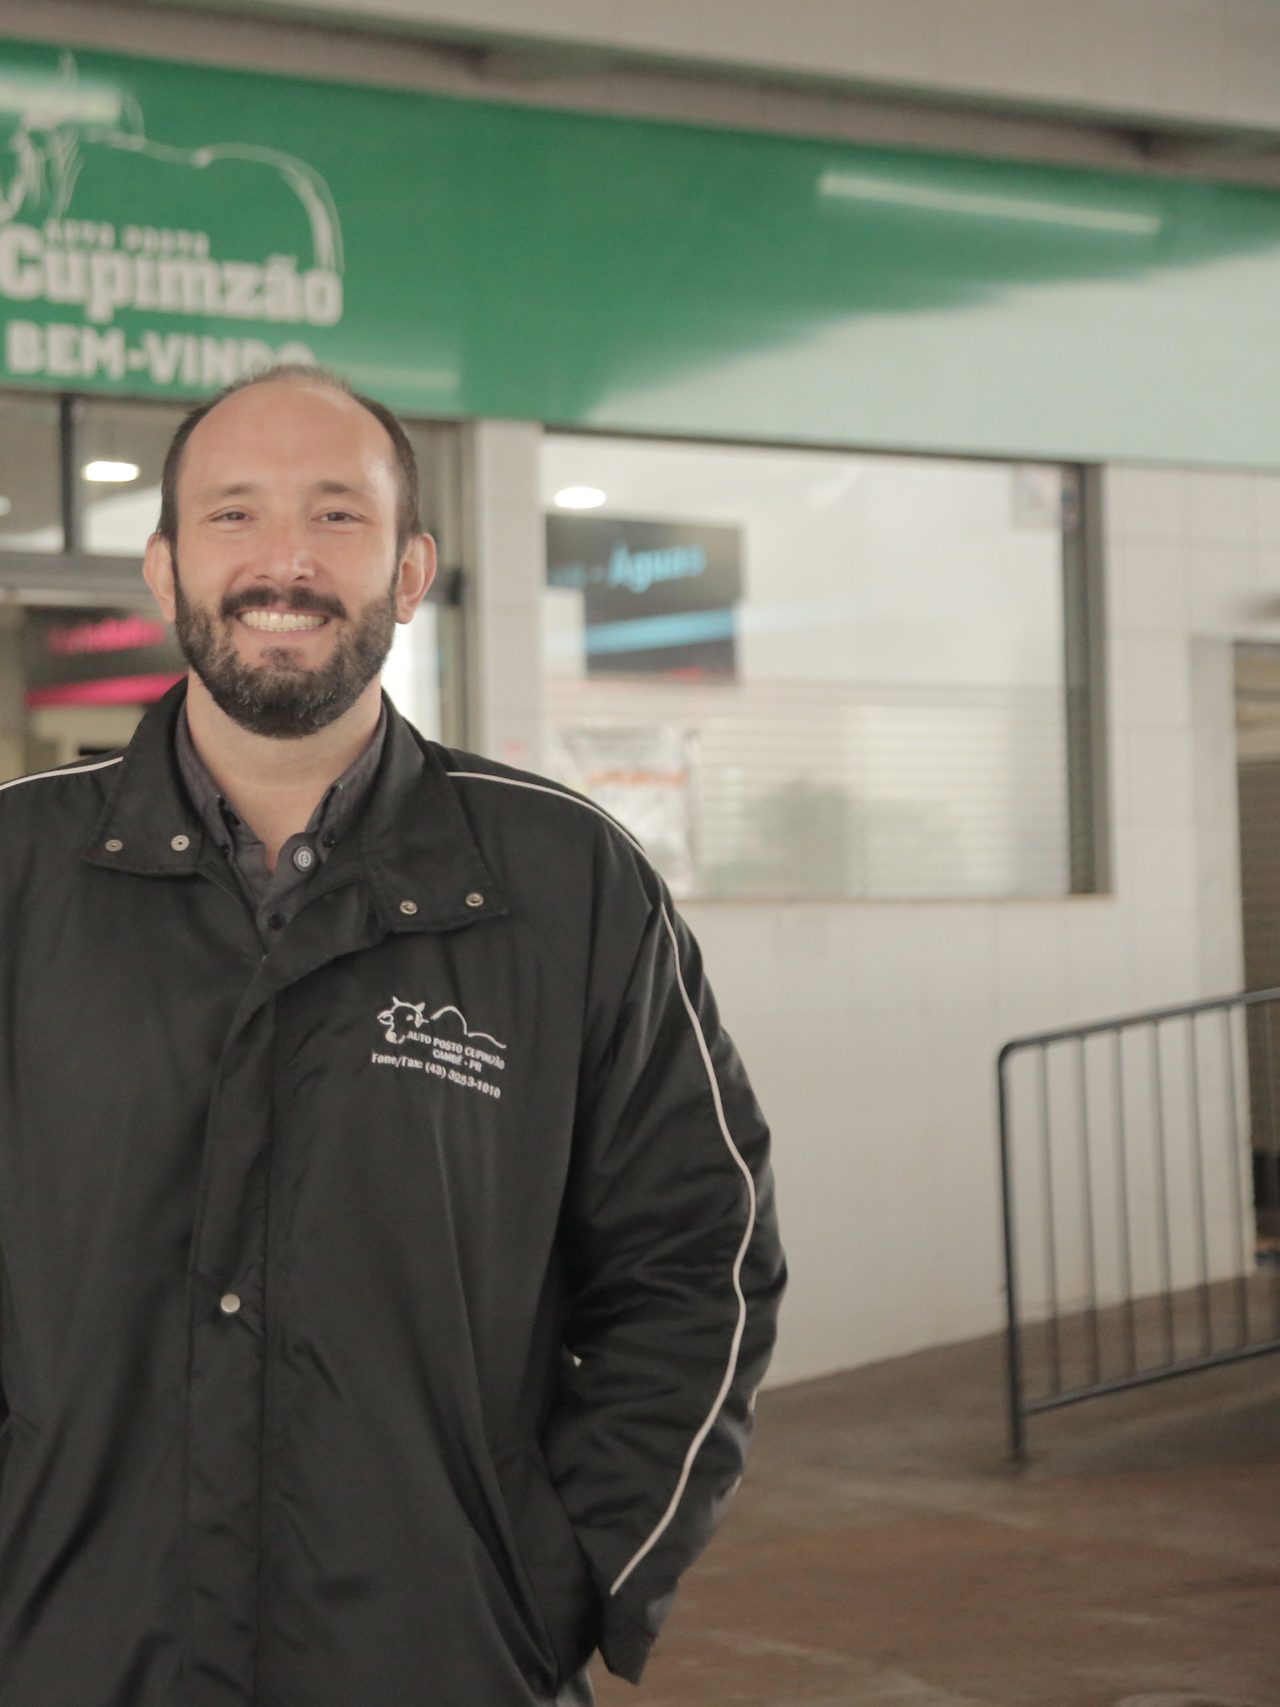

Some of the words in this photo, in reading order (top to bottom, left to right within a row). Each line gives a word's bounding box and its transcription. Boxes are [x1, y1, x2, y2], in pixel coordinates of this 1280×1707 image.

[406, 1030, 432, 1045] AUTO
[433, 1037, 463, 1054] POSTO
[425, 1061, 447, 1079] (43)
[469, 1059, 483, 1073] PR
